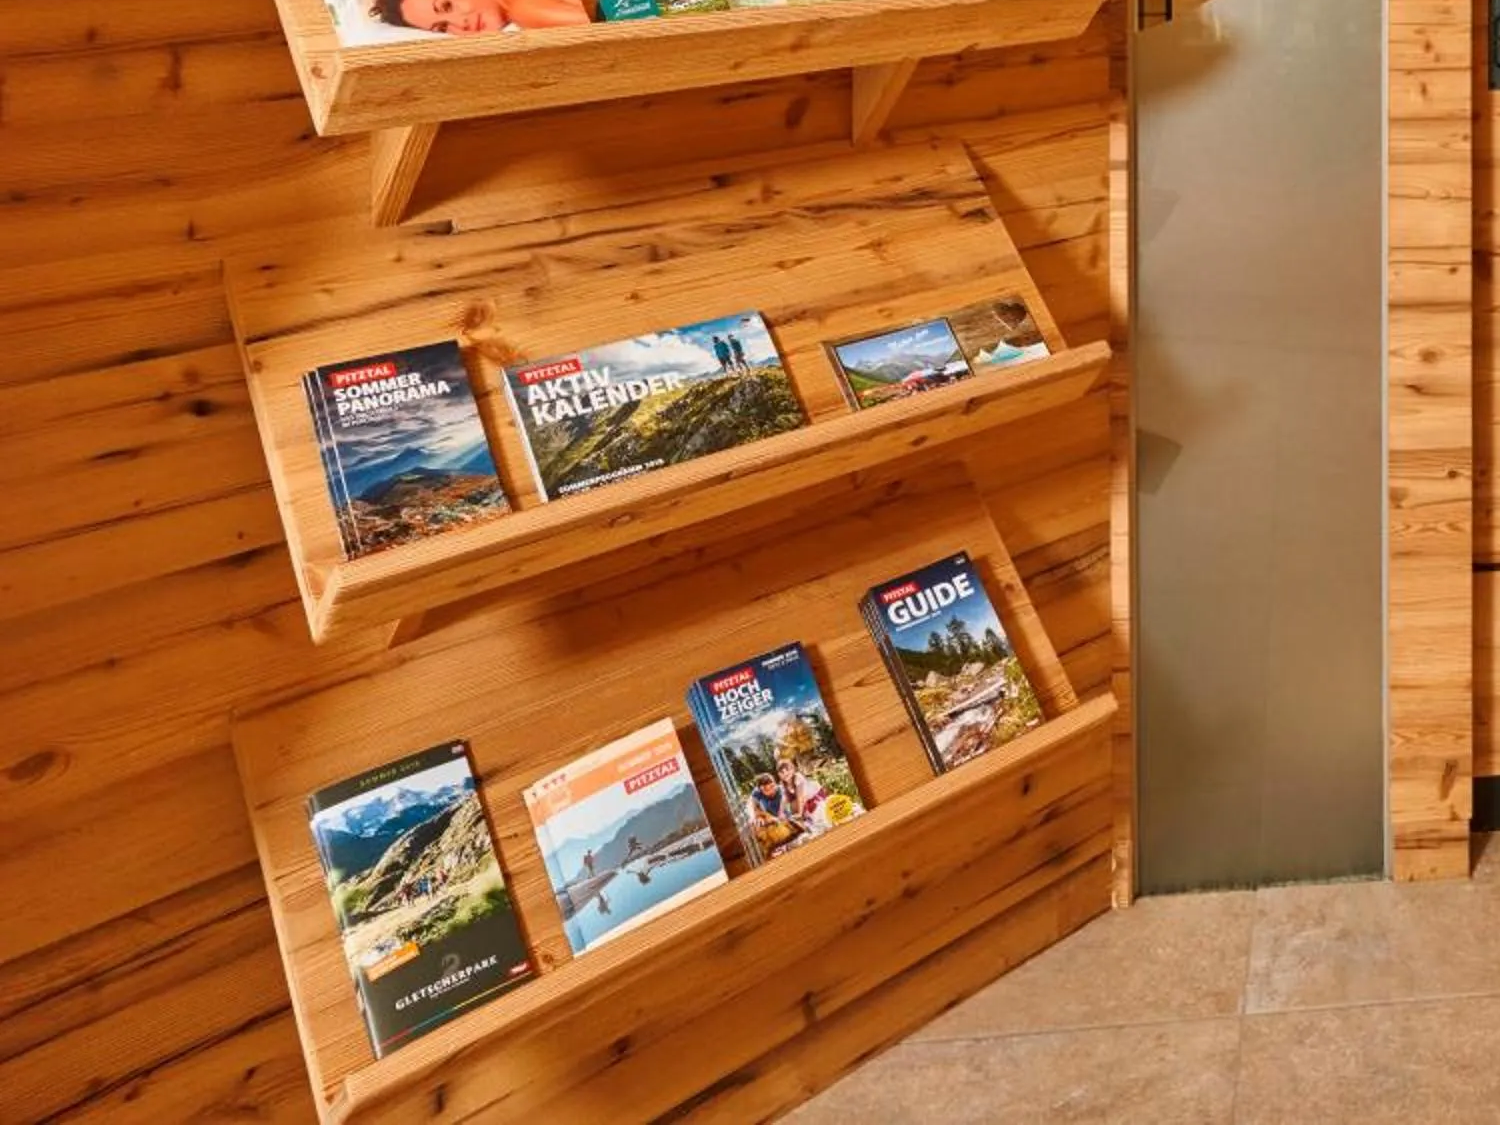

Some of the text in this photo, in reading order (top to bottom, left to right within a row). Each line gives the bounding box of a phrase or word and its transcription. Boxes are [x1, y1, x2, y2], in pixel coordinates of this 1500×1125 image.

[336, 365, 393, 386] PITZTAL
[524, 361, 577, 380] PITZTAL
[527, 366, 610, 406] AKTIV
[334, 372, 422, 402] SOMMER
[337, 380, 451, 416] PANORAMA
[531, 372, 683, 425] KALENDER
[888, 573, 975, 624] GUIDE
[713, 679, 760, 709] HOCH
[718, 688, 774, 720] ZEIGER
[628, 762, 676, 790] PITZTAL
[394, 954, 498, 1011] GLETSCHERPARK
